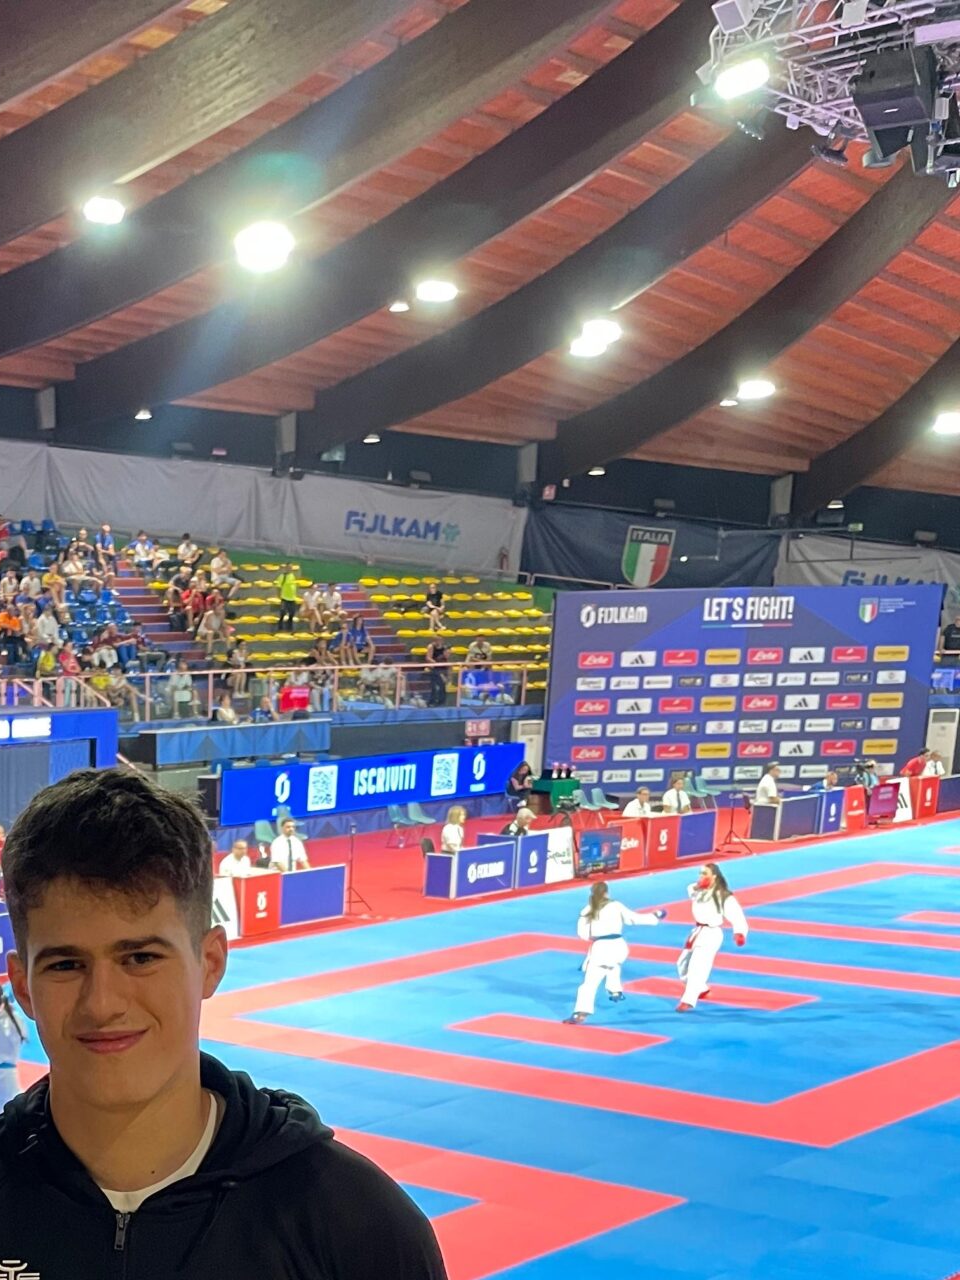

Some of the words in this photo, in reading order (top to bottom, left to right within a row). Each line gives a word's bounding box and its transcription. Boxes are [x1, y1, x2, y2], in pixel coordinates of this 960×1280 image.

[631, 530, 671, 543] ITALIA
[702, 597, 744, 621] LET'S
[745, 596, 795, 621] FIGHT!
[353, 764, 417, 796] ISCRIVITI
